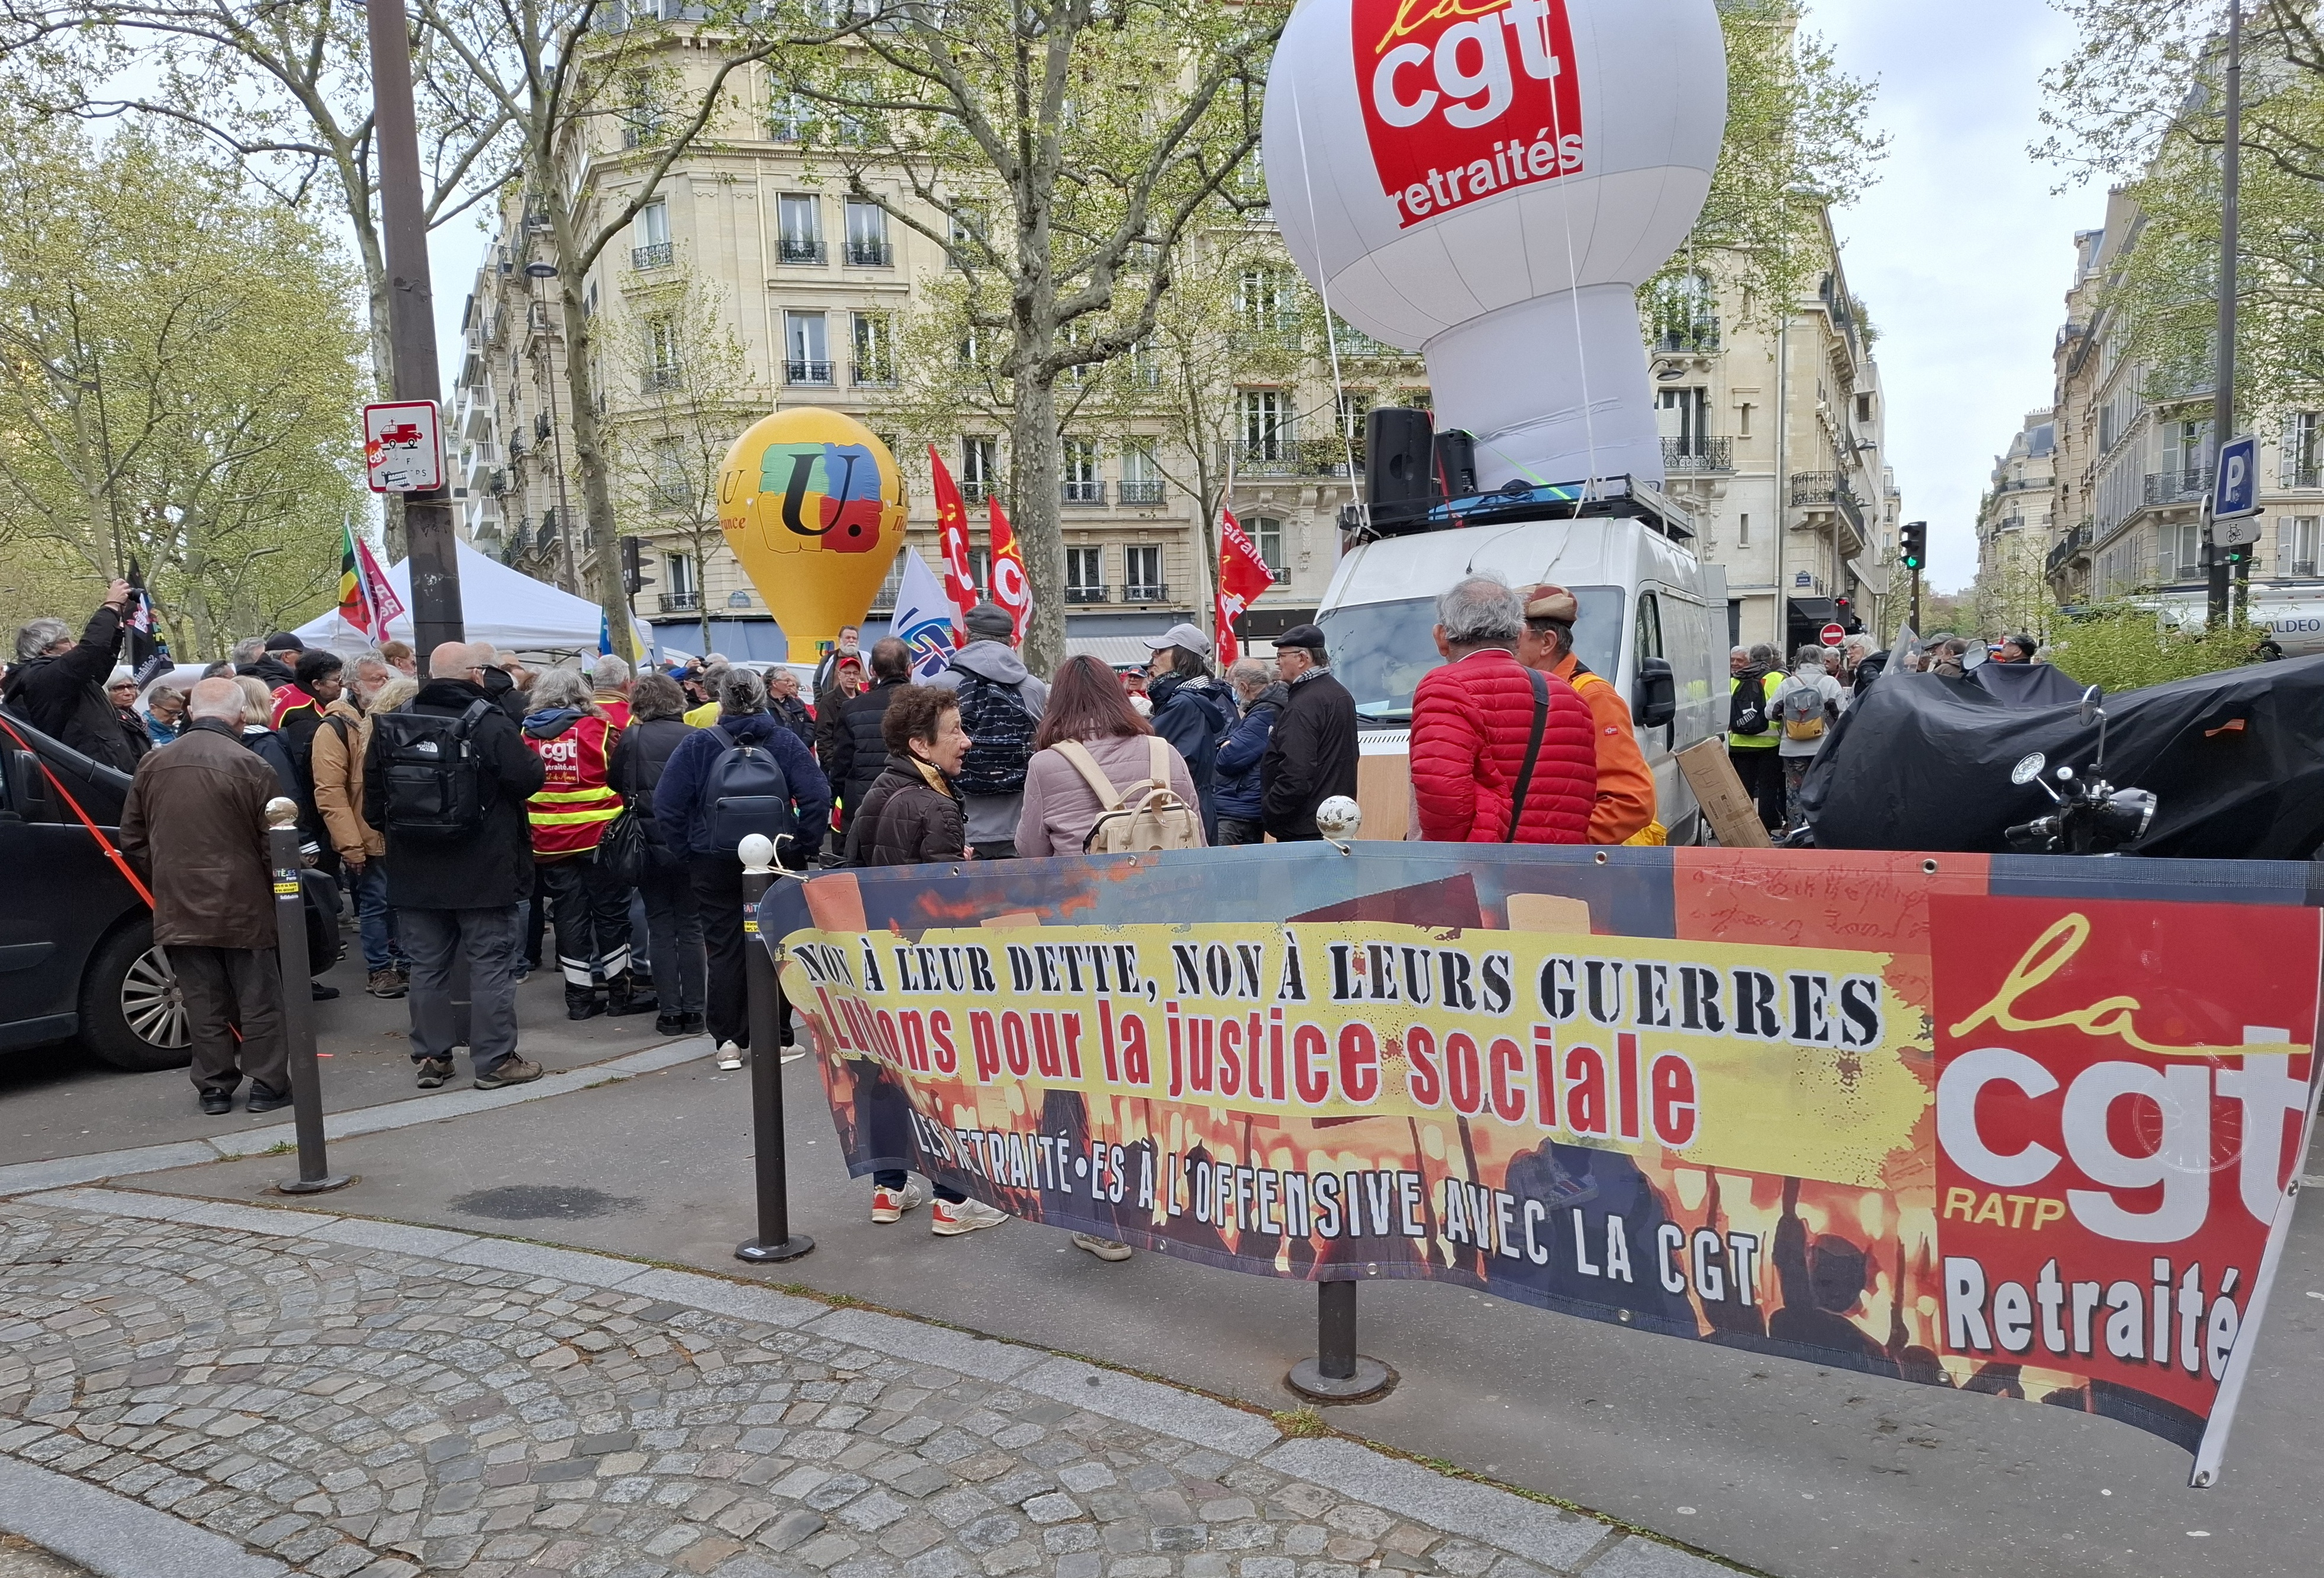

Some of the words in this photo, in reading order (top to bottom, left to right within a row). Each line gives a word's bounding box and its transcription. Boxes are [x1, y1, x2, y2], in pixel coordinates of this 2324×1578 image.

[1373, 0, 1561, 128] cgt
[1387, 127, 1583, 225] retraités
[369, 447, 385, 464] cgt
[2225, 455, 2245, 502] P
[720, 516, 746, 531] rance
[540, 738, 577, 762] cgt
[792, 944, 855, 988] NON
[863, 938, 885, 992] À
[894, 946, 996, 993] LEUR
[1007, 945, 1157, 1002] DETTE,
[1171, 944, 1263, 997] NON
[1278, 931, 1306, 1001] À
[1330, 945, 1512, 1014] LEURS
[1540, 958, 1879, 1047] GUERRES
[1948, 912, 2311, 1055] la
[969, 1010, 1083, 1082] pour
[1097, 999, 1151, 1084] la
[1166, 1001, 1378, 1103] justice
[1406, 1025, 1695, 1145] sociale
[1936, 1025, 2310, 1243] cgt
[909, 1106, 951, 1161] LES
[1138, 1143, 1154, 1210] À
[1167, 1153, 1425, 1238] L'OFFENSIVE
[1447, 1180, 1549, 1264] AVEC
[1572, 1209, 1633, 1283] LA
[1658, 1223, 1758, 1306] CGT
[1943, 1188, 2066, 1230] RATP
